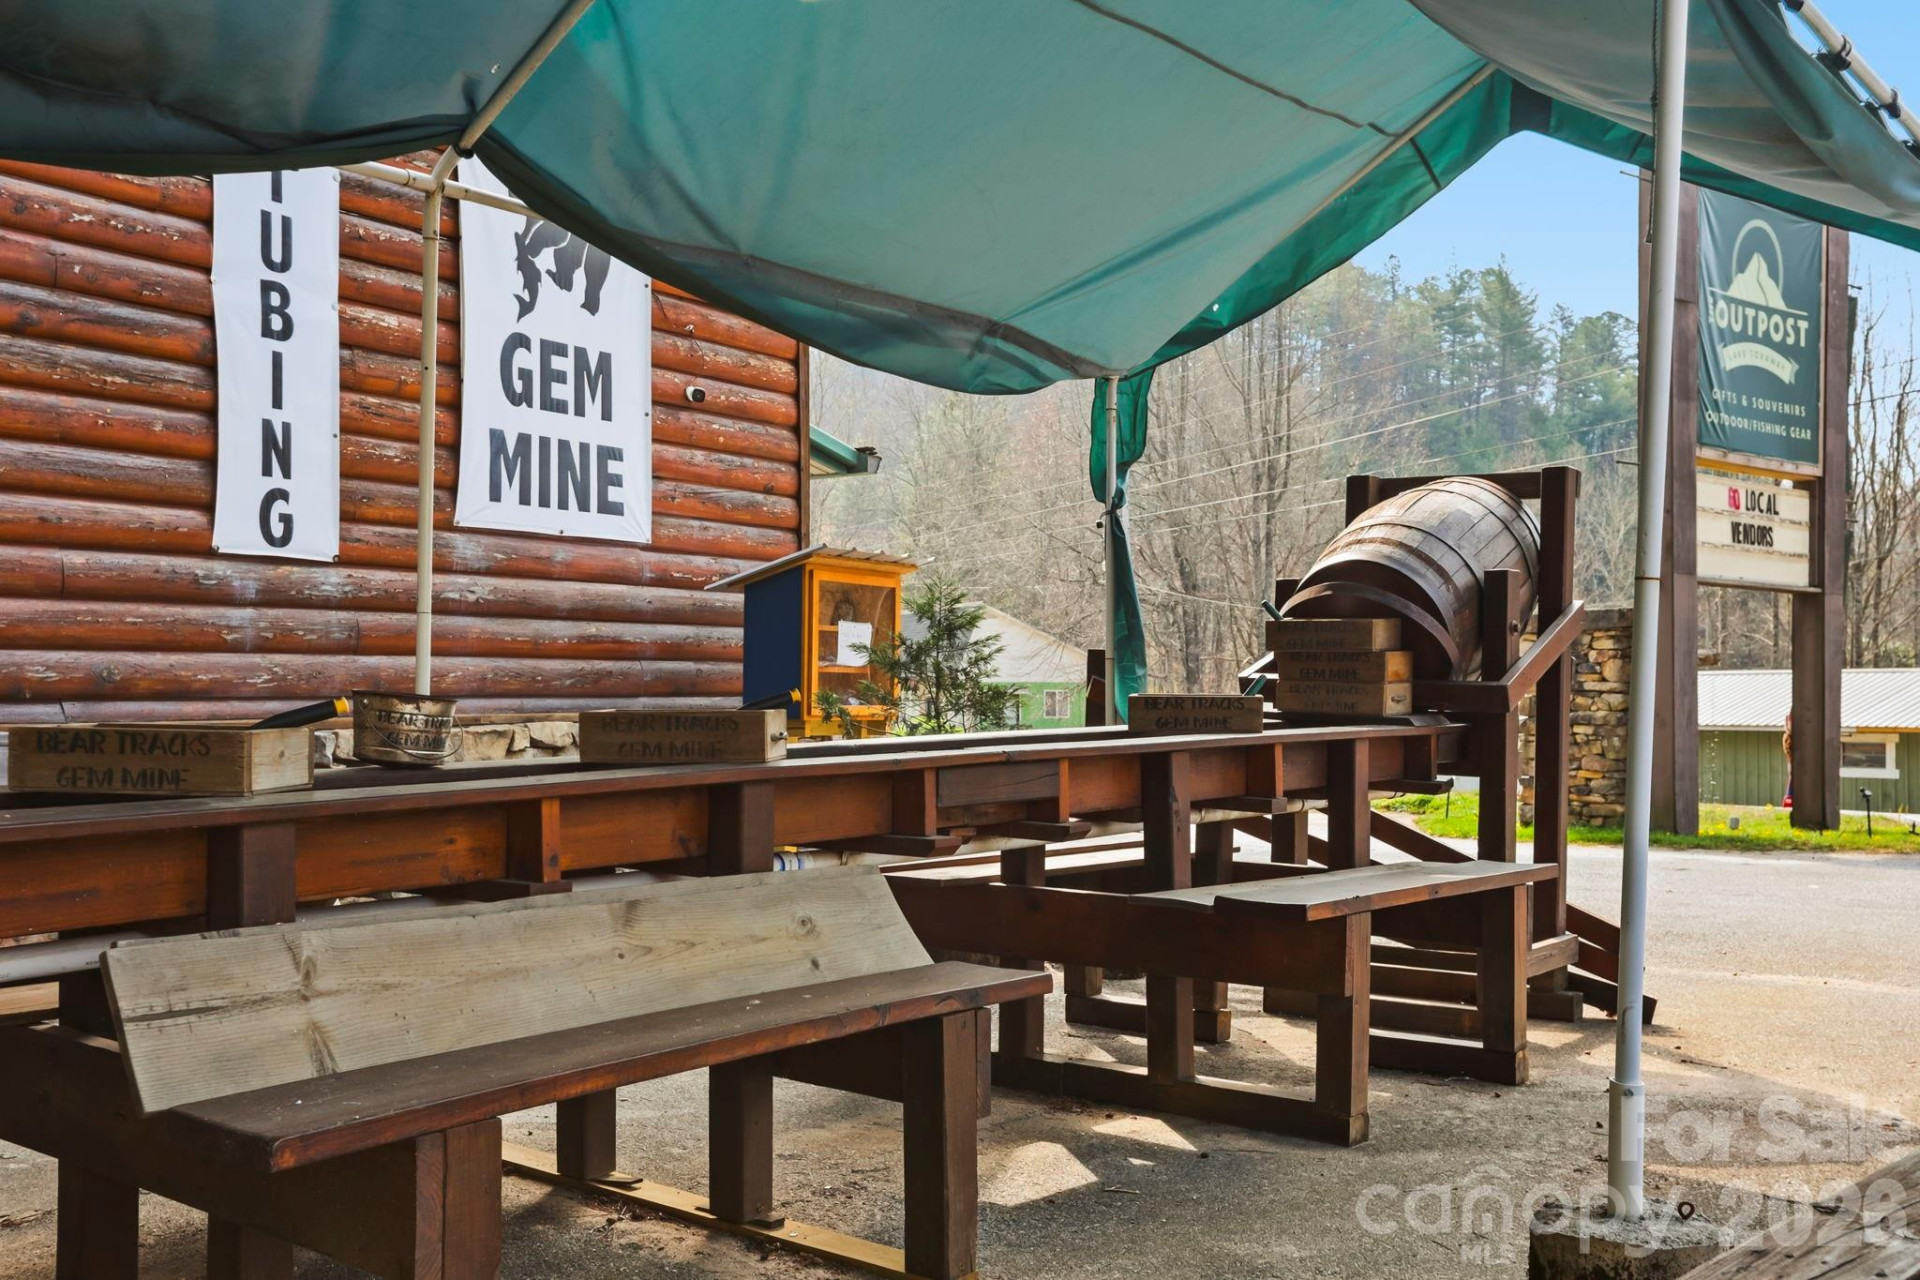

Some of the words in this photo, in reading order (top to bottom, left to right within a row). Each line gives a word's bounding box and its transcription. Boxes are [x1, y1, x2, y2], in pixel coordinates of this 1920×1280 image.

[1715, 299, 1808, 347] OUTPOST
[500, 332, 613, 422] GEM
[1752, 397, 1806, 417] SOUVENIRS
[1706, 410, 1787, 437] OUTDOOR/FISHING
[1790, 427, 1812, 440] GEAR
[489, 428, 625, 517] MINE
[1745, 489, 1780, 515] LOCAL
[1731, 521, 1774, 547] VENDORS
[1299, 667, 1326, 679] GEM
[1144, 697, 1184, 711] BEAR
[1190, 697, 1246, 712] TRACKS
[600, 714, 655, 732] BEAR
[664, 715, 740, 733] TRACKS
[1154, 715, 1189, 730] GEM
[1192, 715, 1233, 730] MINE
[36, 729, 106, 754] BEAR
[113, 730, 211, 758] TRACKS
[617, 741, 662, 759] GEM
[668, 741, 722, 760] MINE
[56, 765, 114, 789] GEM
[121, 766, 191, 790] MINE
